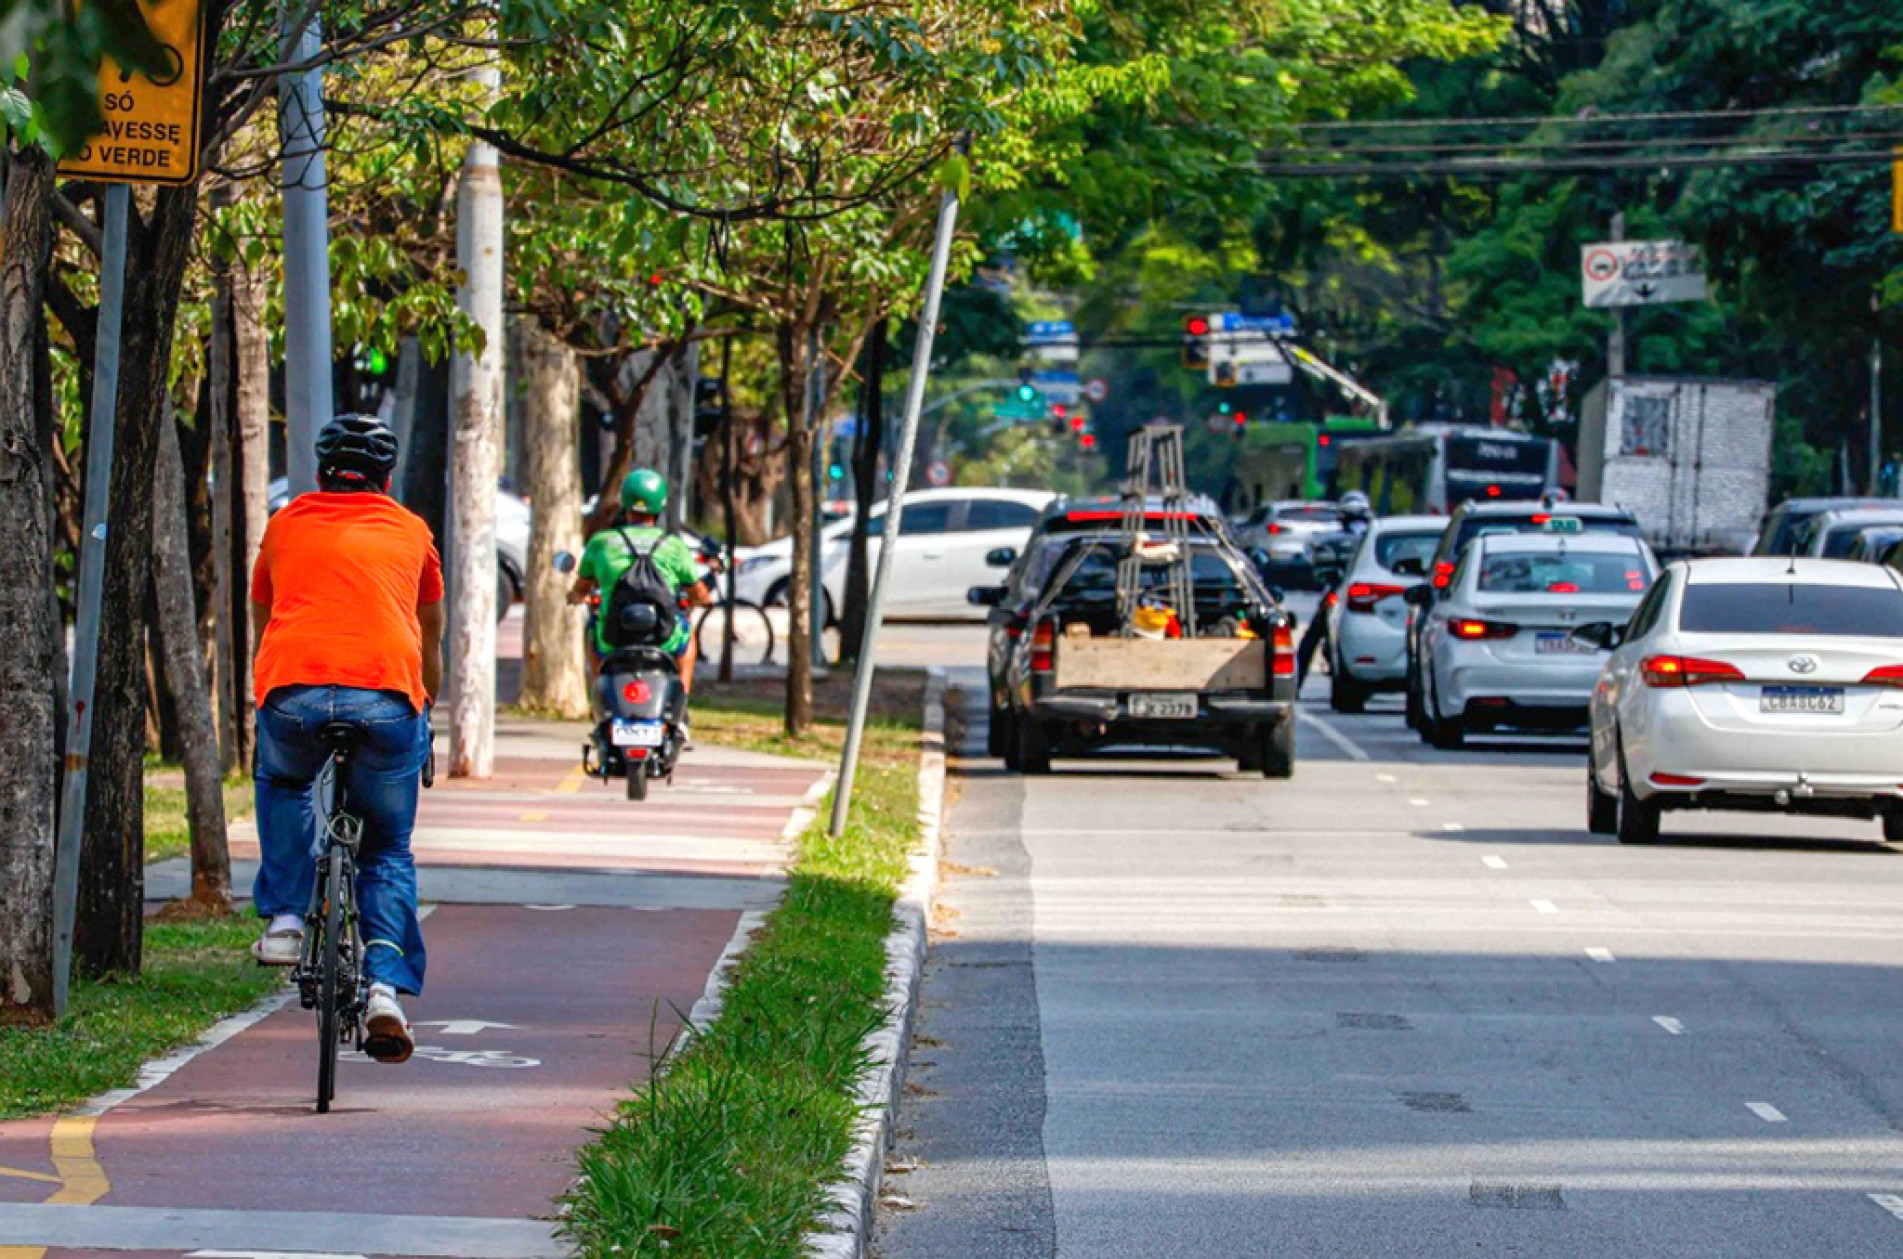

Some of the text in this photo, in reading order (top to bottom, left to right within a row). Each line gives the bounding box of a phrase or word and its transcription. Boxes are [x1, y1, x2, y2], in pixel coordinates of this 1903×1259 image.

[104, 90, 134, 111] SÓ
[101, 121, 180, 141] AVESSE
[99, 146, 170, 167] VERDE
